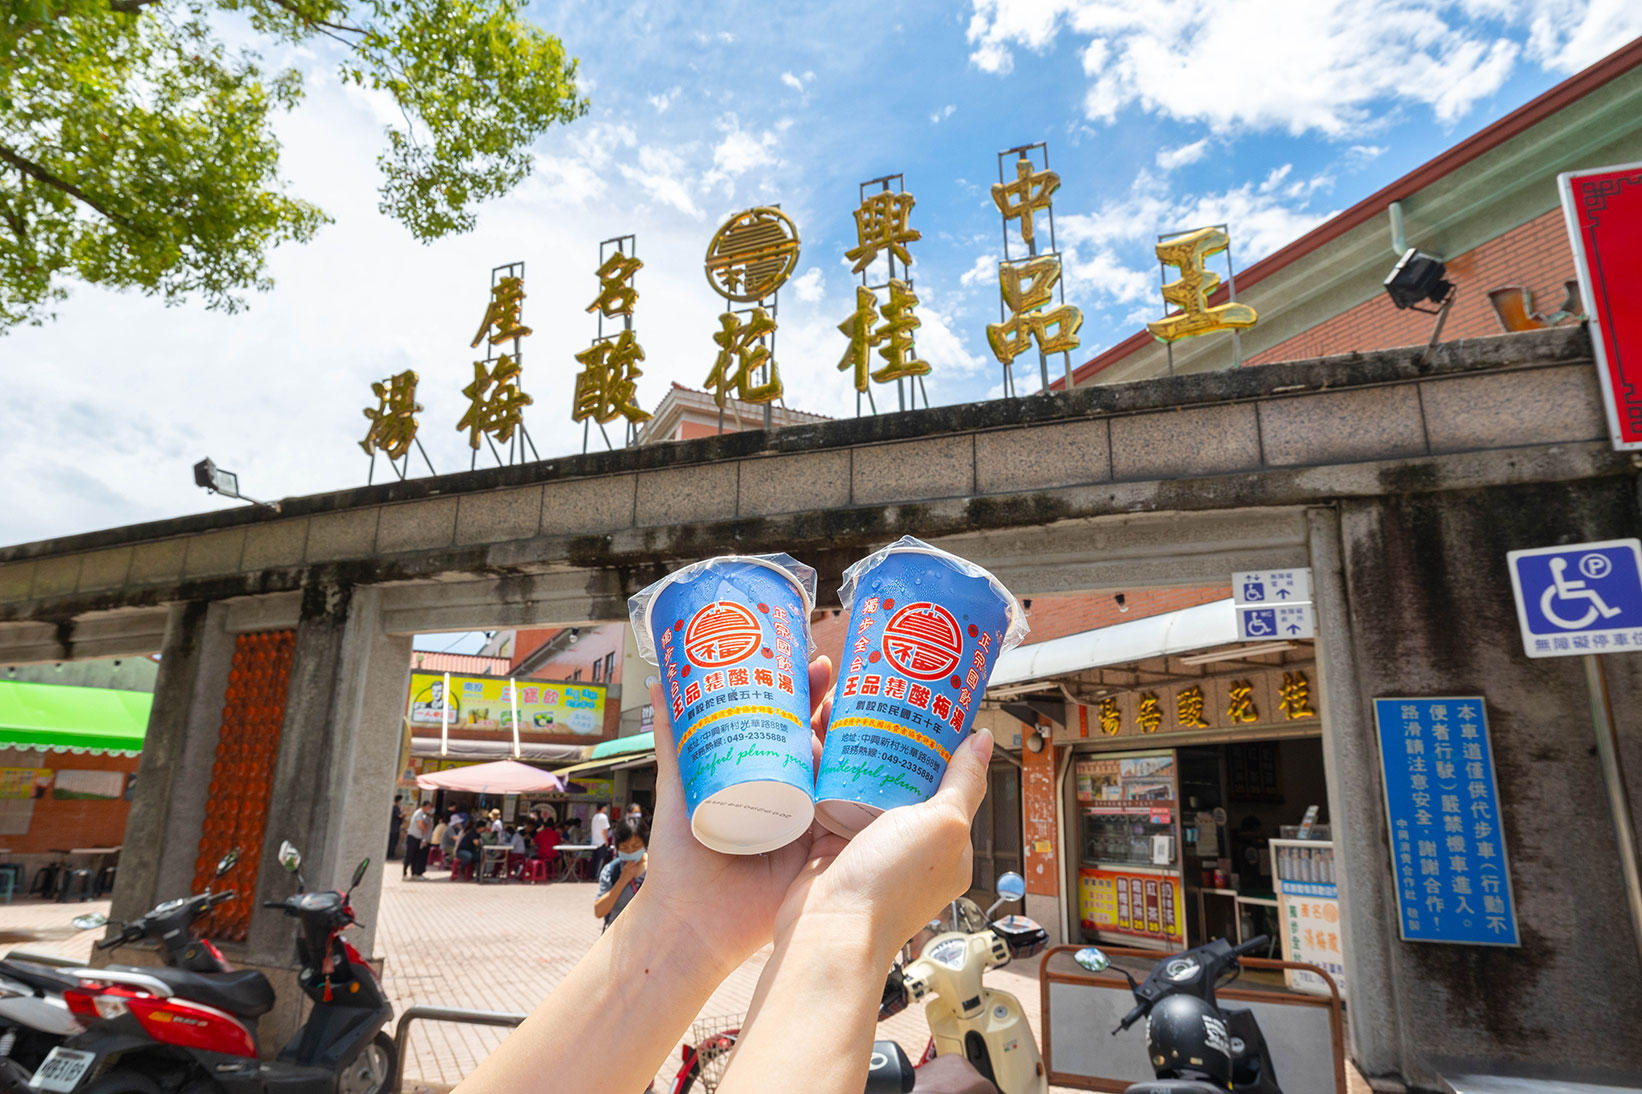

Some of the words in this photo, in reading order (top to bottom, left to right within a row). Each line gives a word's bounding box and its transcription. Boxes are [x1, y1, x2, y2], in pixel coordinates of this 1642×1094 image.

[772, 605, 795, 676] 正宗國飲
[849, 596, 881, 674] 獨步全台
[958, 631, 993, 712] 正宗國飲
[736, 743, 780, 766] plum
